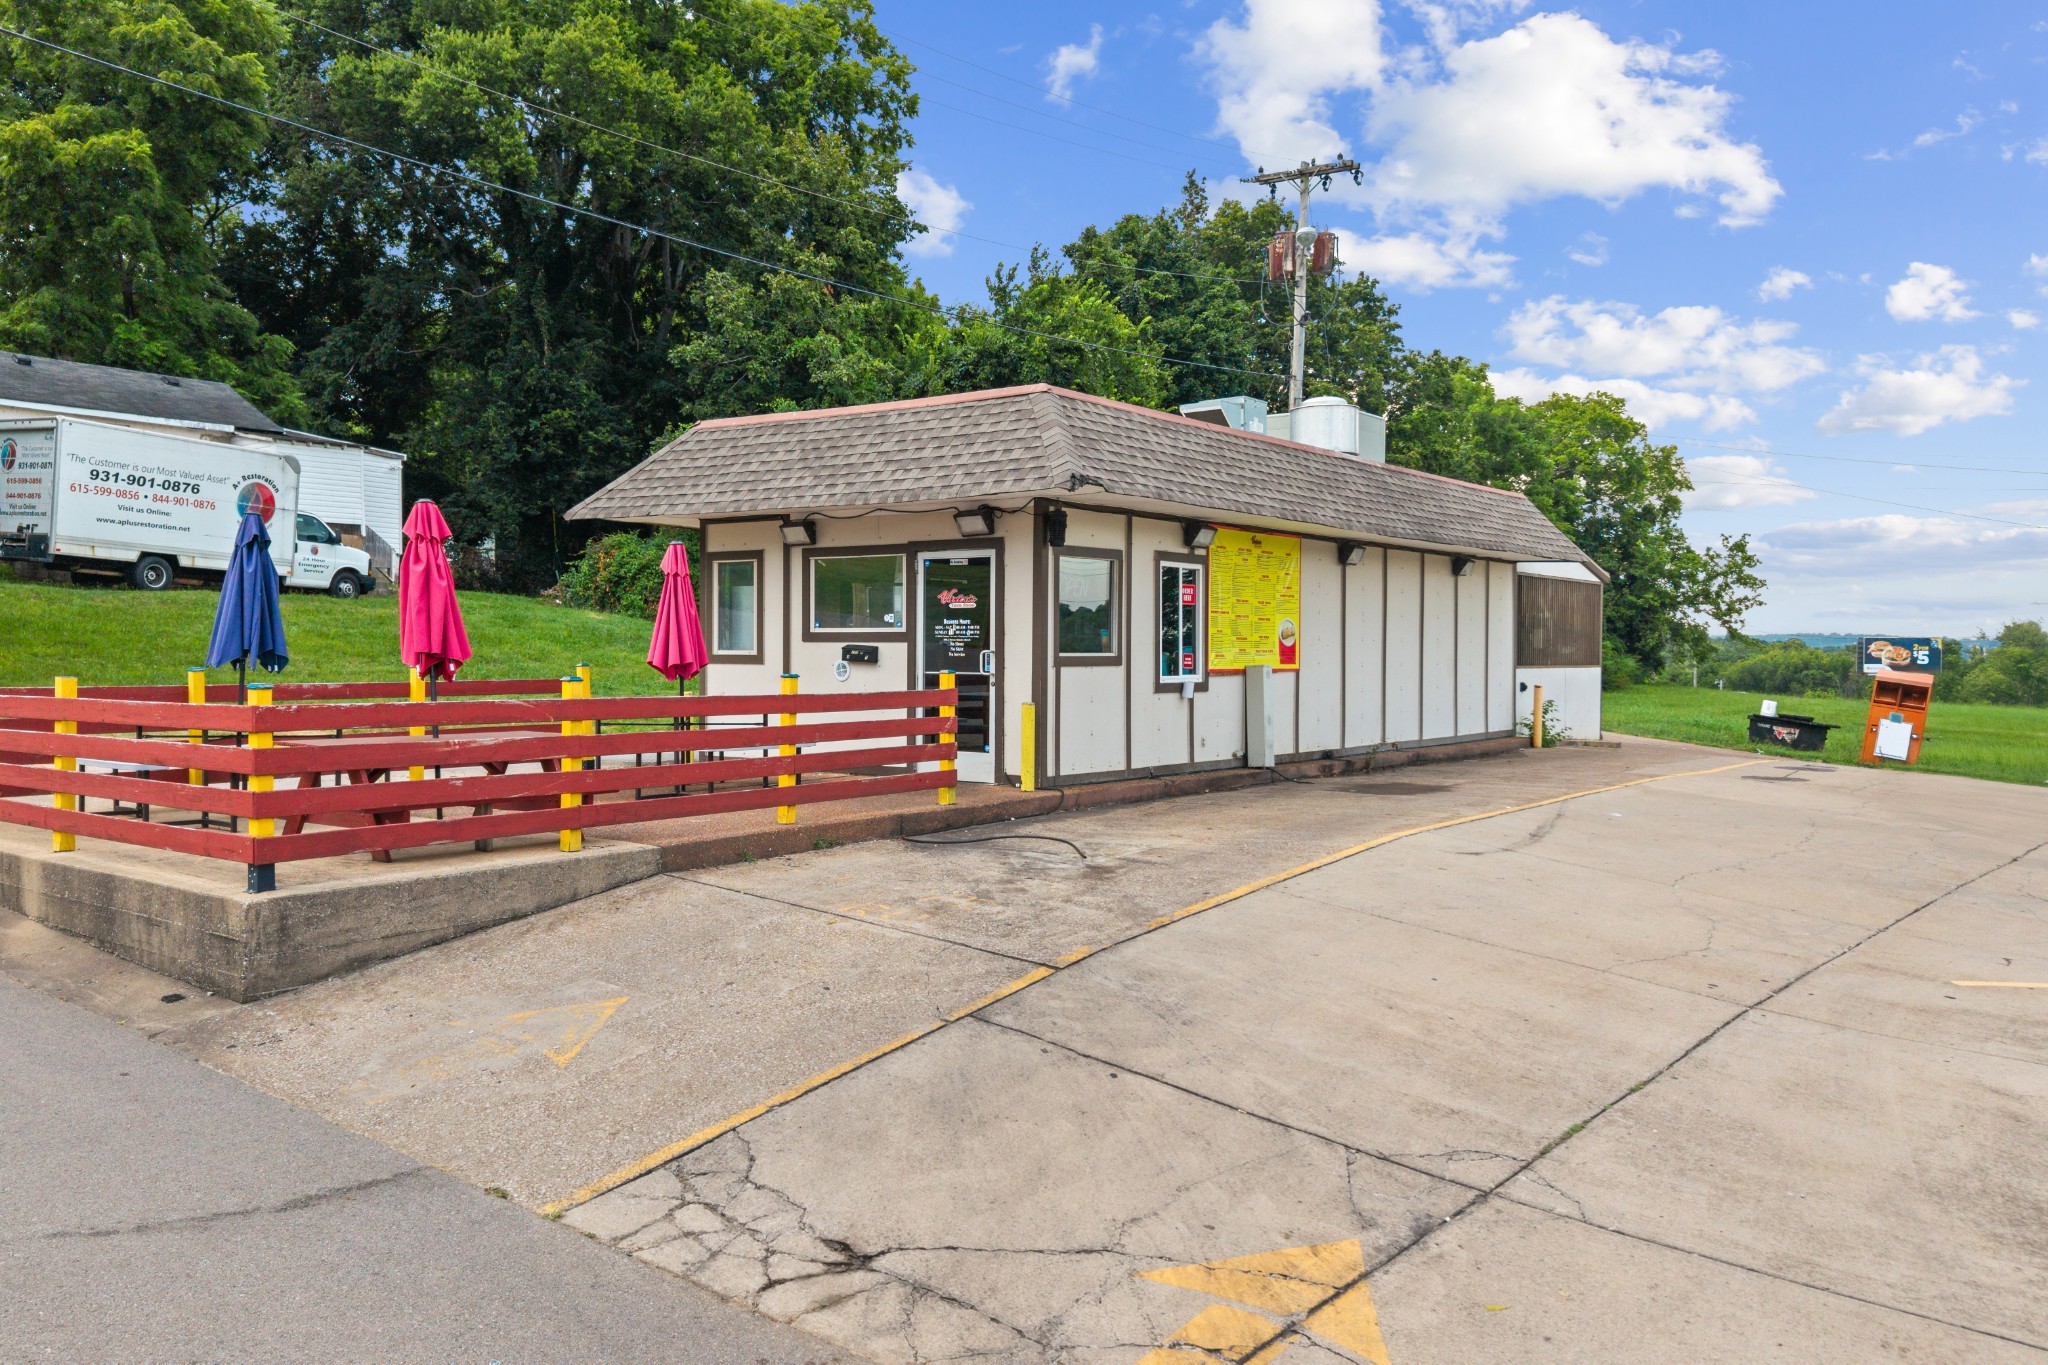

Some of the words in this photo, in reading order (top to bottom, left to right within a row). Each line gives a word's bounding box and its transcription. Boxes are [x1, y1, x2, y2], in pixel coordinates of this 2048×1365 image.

[88, 456, 130, 470] Customer
[132, 462, 139, 472] is
[141, 466, 155, 474] our
[156, 466, 177, 477] Most
[179, 470, 205, 481] Valued
[89, 469, 201, 495] 931-901-0876
[241, 473, 279, 494] Restoration
[70, 482, 140, 501] 615-599-0856
[151, 493, 216, 511] 844-901-0876
[117, 504, 134, 513] Visit
[146, 508, 172, 517] Online:
[96, 517, 190, 532] www.aplusrestoration.net
[1060, 577, 1089, 596] OPEN
[1913, 643, 1919, 651] 2
[1913, 650, 1930, 665] $5
